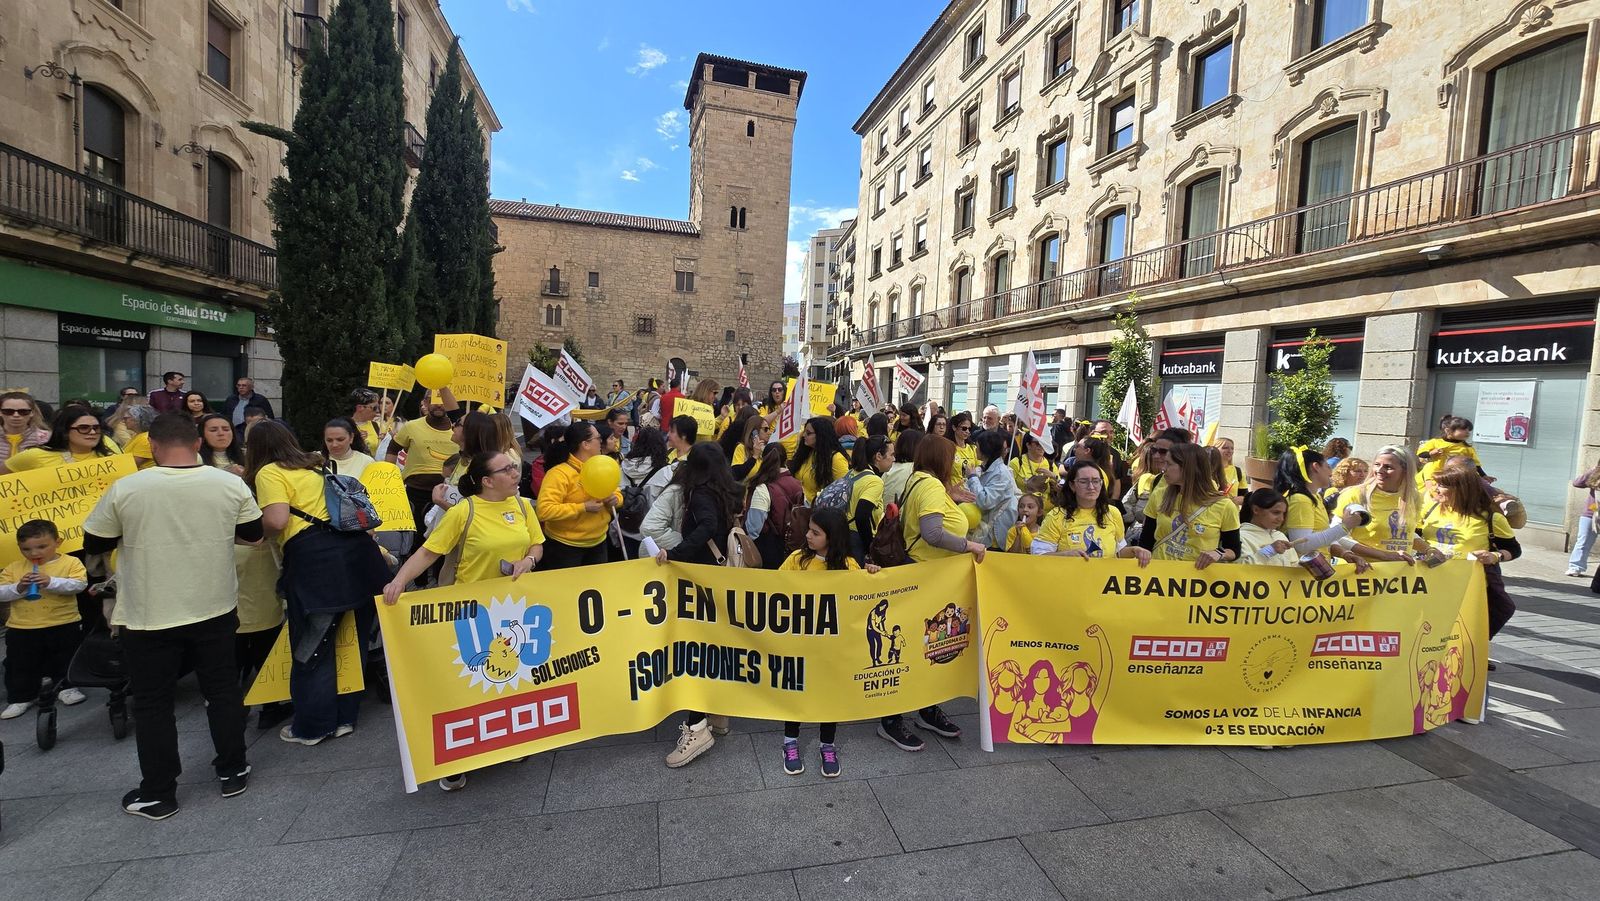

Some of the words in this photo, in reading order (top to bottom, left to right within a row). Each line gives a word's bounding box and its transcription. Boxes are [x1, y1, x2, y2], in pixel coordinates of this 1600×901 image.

[122, 295, 158, 311] Espacio
[160, 301, 172, 313] de
[173, 304, 198, 318] Salud
[200, 308, 227, 322] DKV
[61, 323, 90, 334] Espacio
[91, 326, 101, 335] de
[101, 328, 121, 337] Salud
[123, 330, 146, 339] DKV
[1437, 342, 1567, 365] kutxabank
[1162, 361, 1216, 375] kutxabank
[527, 381, 564, 411] CCOO
[56, 460, 117, 484] EDUCAR
[23, 482, 98, 510] CORAZONES
[849, 593, 875, 601] PORQUE
[876, 591, 889, 599] NOS
[890, 585, 919, 596] IMPORTAN
[1101, 576, 1270, 600] ABANDONO
[1278, 580, 1292, 599] Y
[1300, 576, 1428, 599] VIOLENCIA
[410, 600, 478, 626] MALTRATO
[578, 589, 604, 634] 0
[643, 580, 667, 625] 3
[677, 578, 716, 623] EN
[726, 589, 838, 635] LUCHA
[1188, 604, 1355, 625] INSTITUCIONAL
[1010, 640, 1042, 648] MENOS
[1045, 641, 1080, 650] RATIOS
[1133, 640, 1203, 657] CCOO
[1314, 635, 1375, 652] CCOO
[531, 646, 600, 685] SOLUCIONES
[628, 641, 761, 701] ¡SOLUCIONES
[768, 653, 804, 691] YA!
[1128, 663, 1204, 675] enseñanza
[1308, 657, 1382, 670] enseñanza
[854, 668, 895, 681] EDUCACIÓN
[896, 666, 910, 675] 0-3
[863, 680, 879, 691] EN
[882, 676, 900, 689] PIE
[865, 691, 883, 699] Castilla
[1164, 709, 1210, 719] SOMOS
[1213, 709, 1229, 718] LA
[1232, 708, 1258, 718] VOZ
[1264, 707, 1280, 718] DE
[1285, 708, 1300, 718] LA
[1302, 707, 1362, 718] INFANCIA
[445, 696, 569, 750] CCOO
[1205, 724, 1225, 735] 0-3
[1228, 725, 1246, 735] ES
[1249, 723, 1325, 736] EDUCACIÓN
